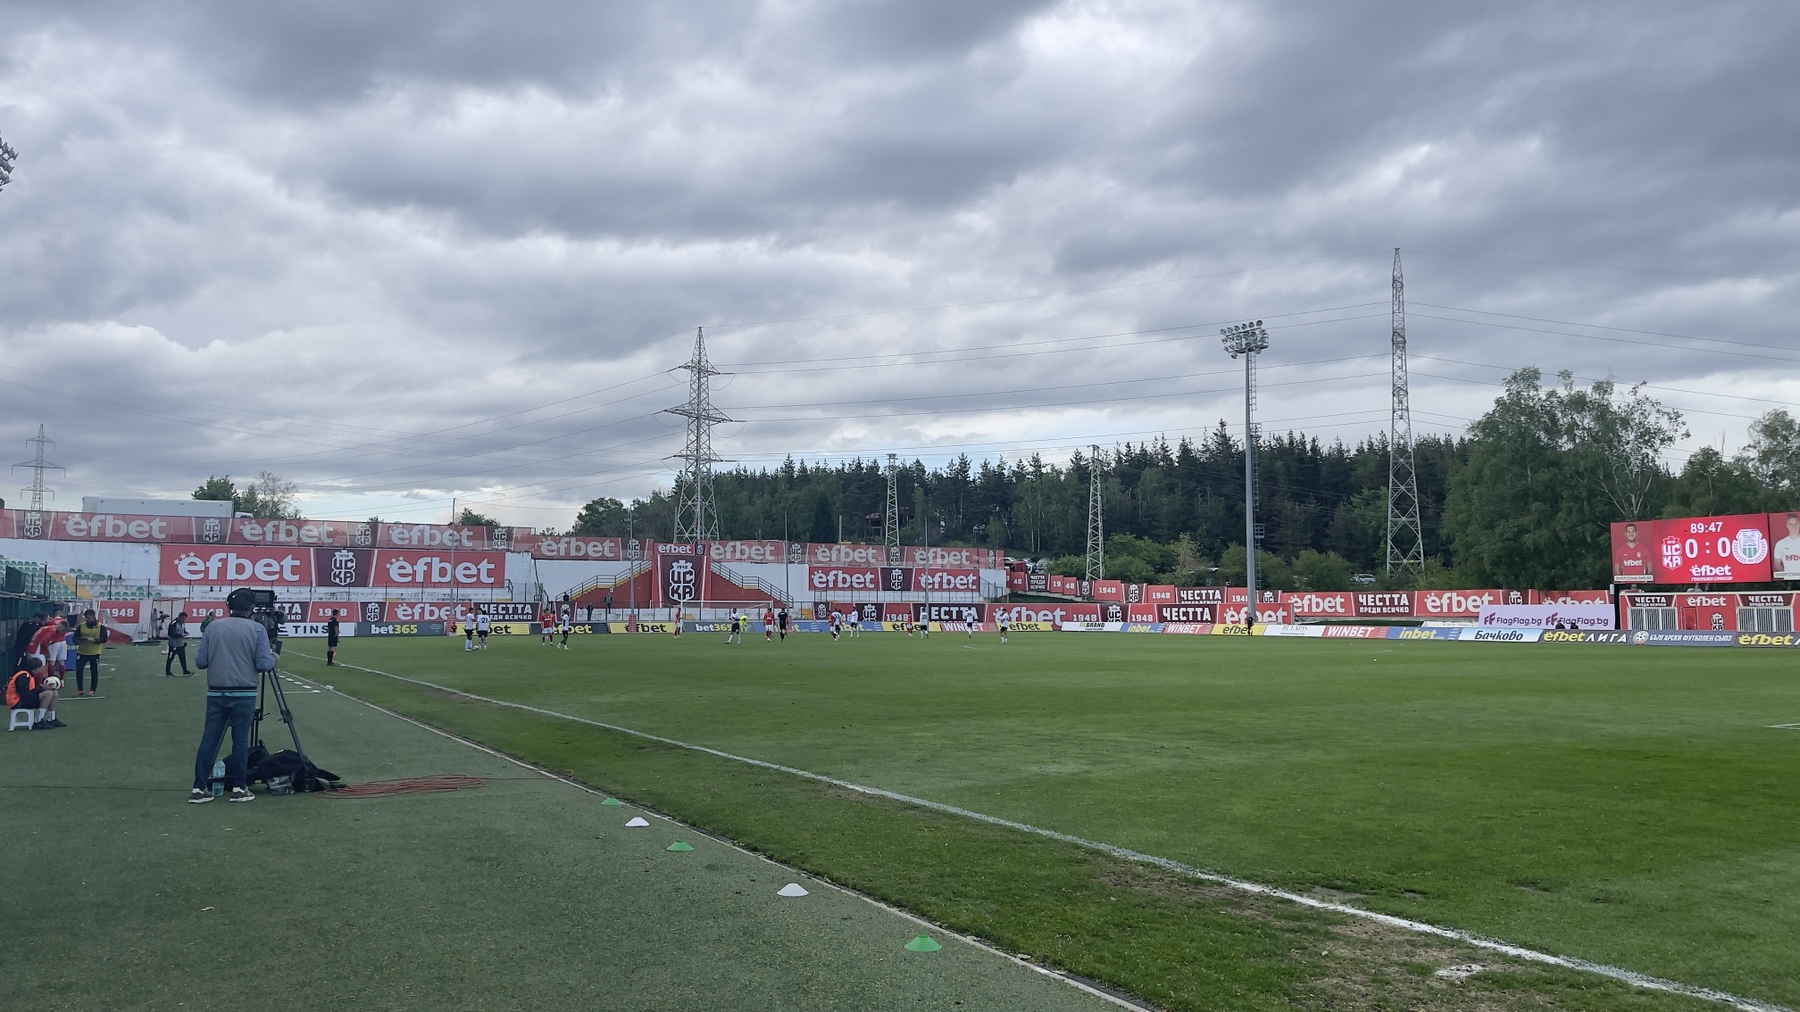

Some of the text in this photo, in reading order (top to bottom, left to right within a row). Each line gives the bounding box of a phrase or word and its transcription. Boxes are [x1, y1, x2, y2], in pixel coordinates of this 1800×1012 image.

[66, 514, 167, 540] efbet
[242, 520, 334, 543] efbet
[1690, 521, 1723, 534] 89:47
[391, 525, 474, 547] efbet
[541, 537, 615, 558] efbet
[658, 544, 692, 554] efbet
[710, 541, 775, 561] efbet
[816, 545, 877, 563] efbet
[1684, 538, 1698, 559] 0
[1717, 536, 1731, 558] 0
[915, 547, 971, 566] efbet
[177, 550, 301, 582] efbet
[389, 556, 496, 584] efbet
[1690, 565, 1732, 577] efbet
[812, 569, 875, 589] efbet
[920, 571, 977, 590] efbet
[1065, 582, 1075, 590] 48
[1098, 586, 1117, 594] 1948
[1180, 589, 1222, 600] ЧЕСТТА
[1358, 593, 1410, 606] ЧЕСТТА
[1748, 595, 1784, 603] ЧЕСТТА
[1293, 593, 1345, 613] efbet
[1426, 591, 1494, 613] efbet
[1687, 596, 1727, 607] efbet
[318, 608, 348, 617] 198
[396, 602, 467, 622] efbet
[480, 603, 533, 614] ЧЕСТТА
[921, 606, 979, 620] ЕСТТА
[1162, 607, 1212, 621] ЧЕСТТА
[886, 613, 908, 622] 1948
[1072, 613, 1097, 622] 1948
[1131, 614, 1153, 622] 1948
[1496, 617, 1542, 626] FlagFlag.bg
[371, 624, 418, 635] bet365
[1010, 622, 1040, 632] efbet
[1127, 624, 1150, 633] inbet
[1166, 624, 1203, 634] WINBET
[1327, 626, 1374, 637] WINBET
[1399, 627, 1436, 640] inbet
[1474, 629, 1524, 641] Бачково
[1543, 630, 1627, 643] efbet ЛИГА
[1738, 633, 1794, 646] efbet
